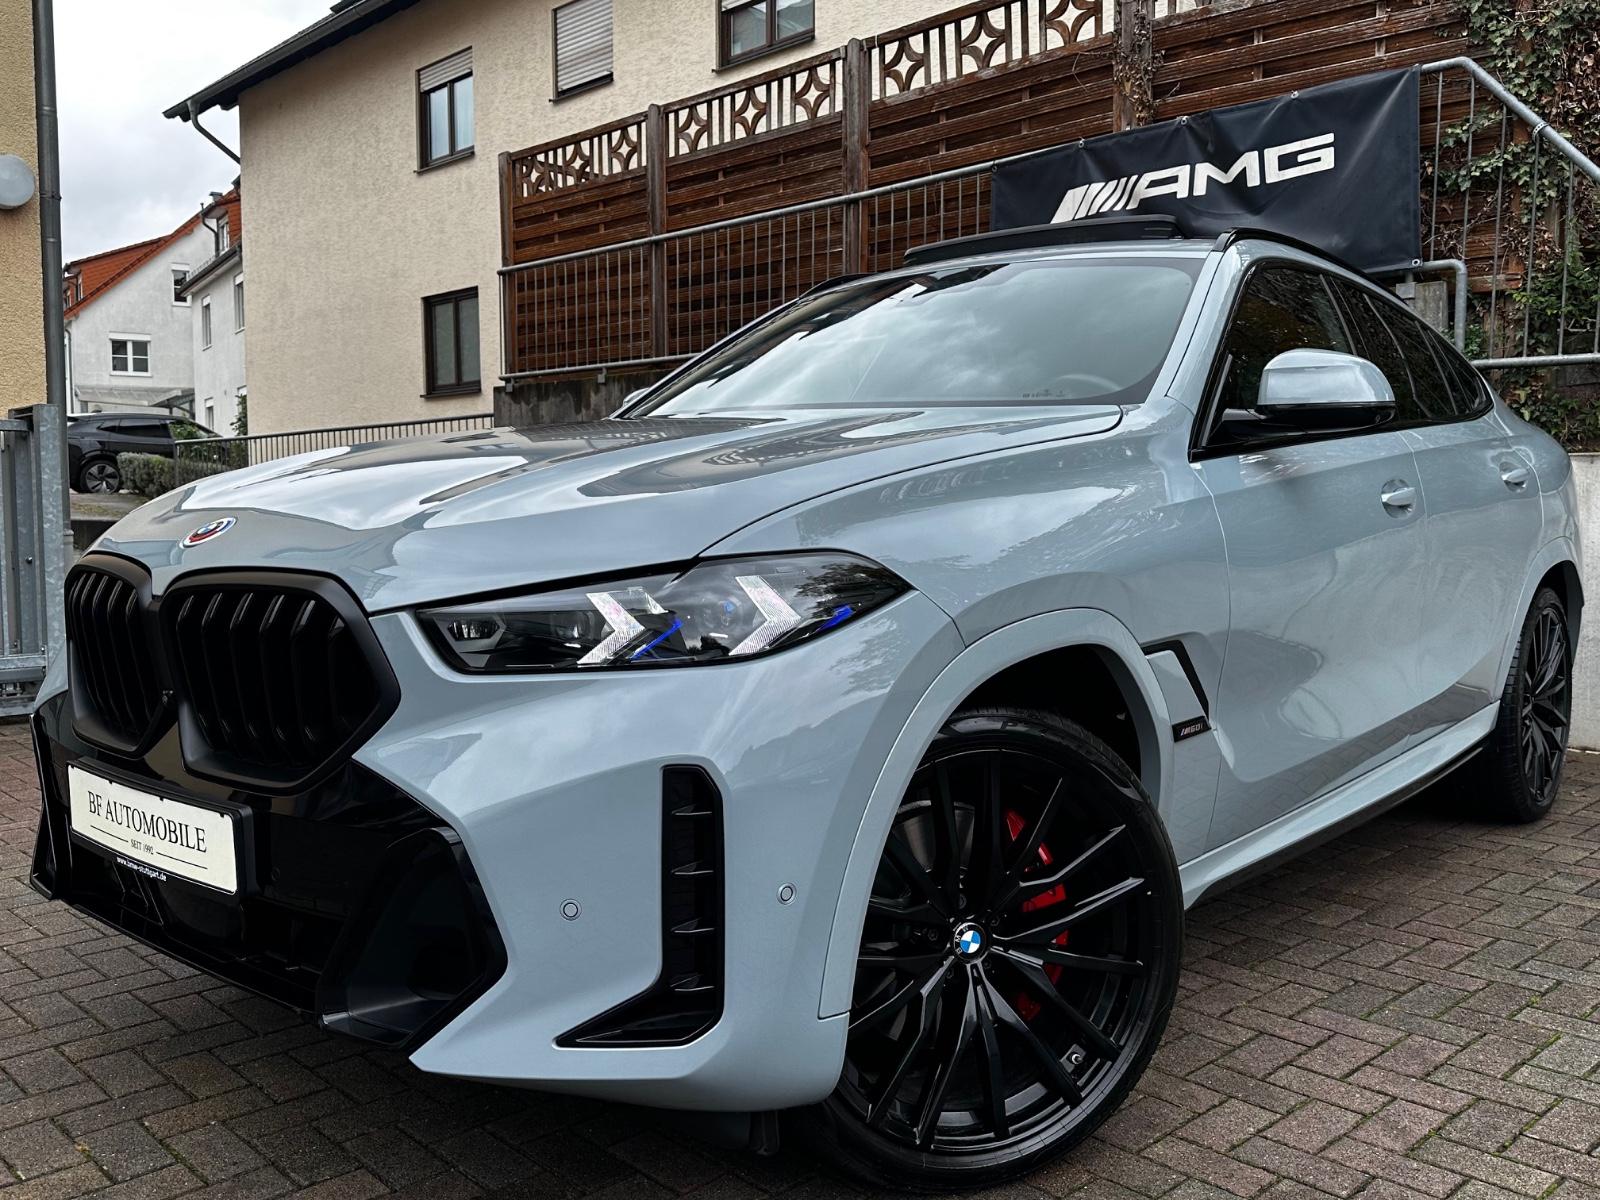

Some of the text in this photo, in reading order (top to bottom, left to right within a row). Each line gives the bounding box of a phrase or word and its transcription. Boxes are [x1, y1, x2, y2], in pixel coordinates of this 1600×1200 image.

[1126, 133, 1334, 209] AMG
[88, 790, 207, 853] BF AUTOMOBILE
[130, 838, 154, 855] SEIT 1992
